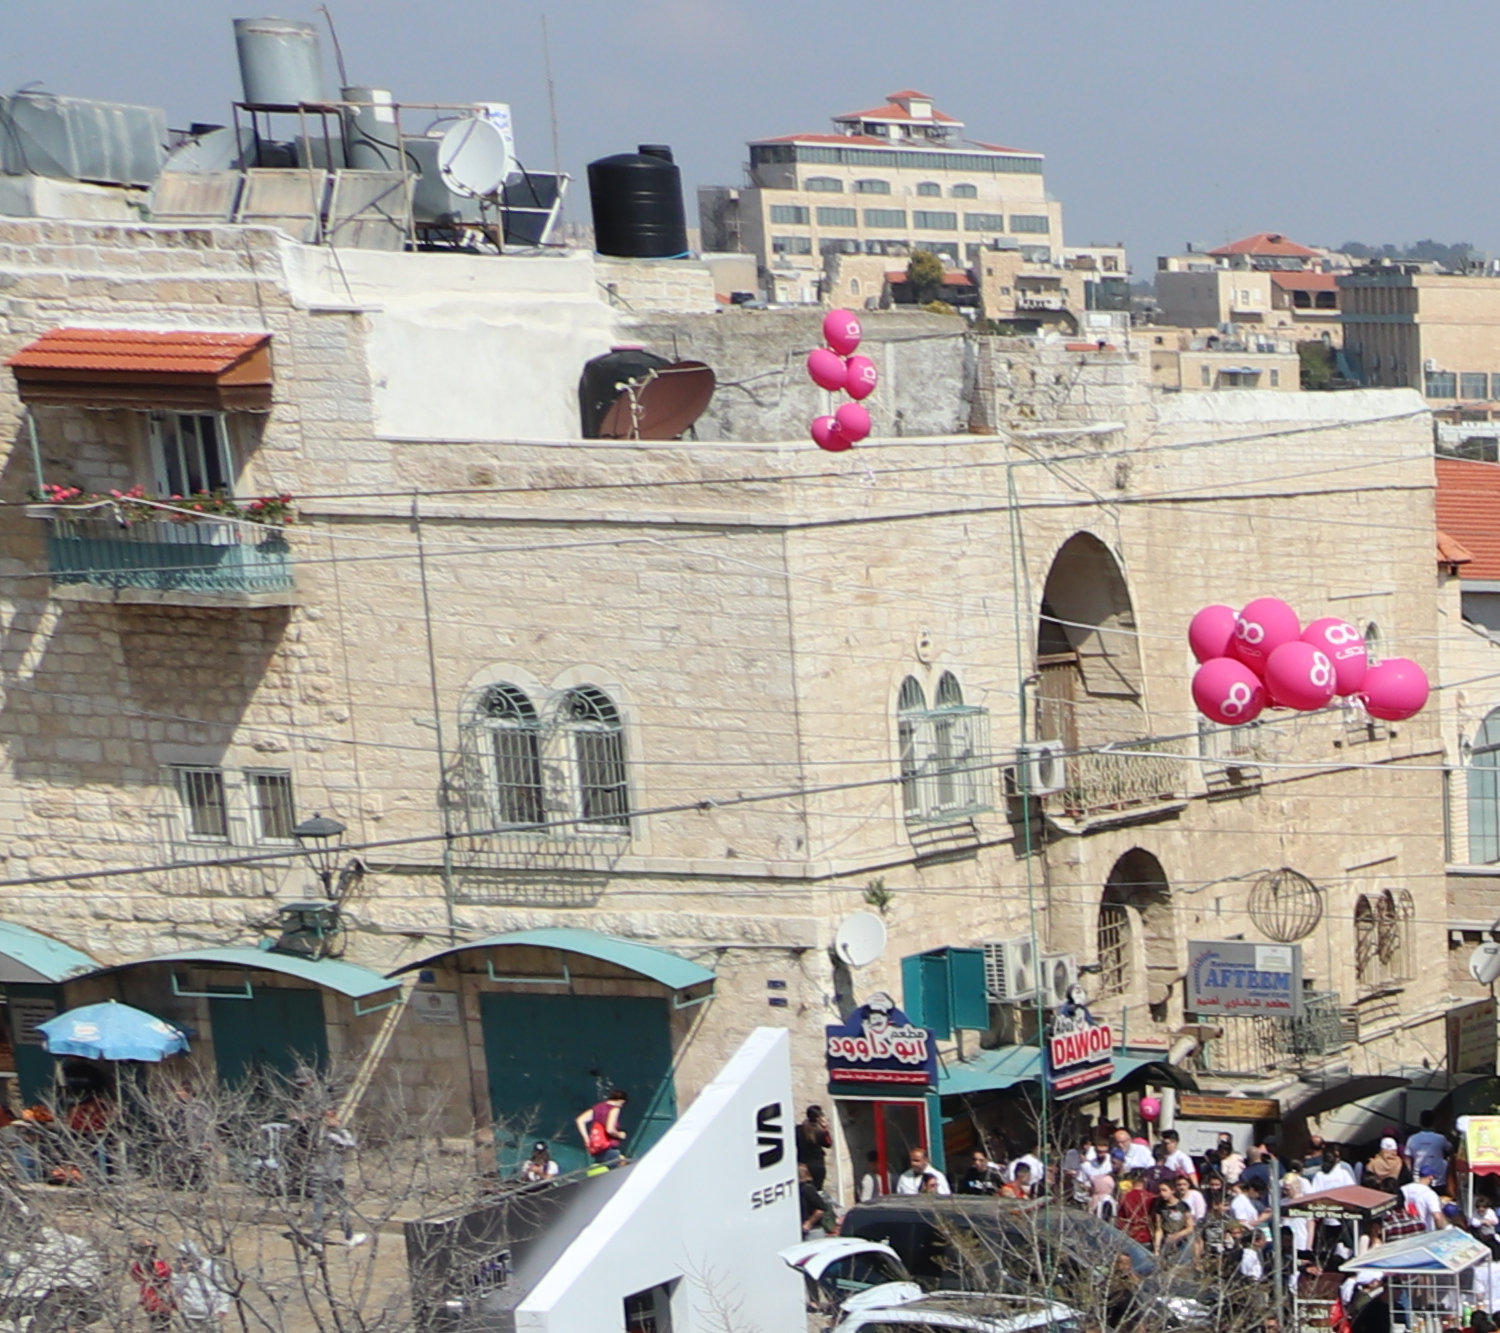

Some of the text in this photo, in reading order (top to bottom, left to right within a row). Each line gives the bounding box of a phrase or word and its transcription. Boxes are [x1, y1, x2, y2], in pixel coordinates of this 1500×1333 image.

[1204, 968, 1291, 992] AFTEEM
[1053, 1027, 1112, 1065] DAWOD
[749, 1178, 797, 1212] SEAT
